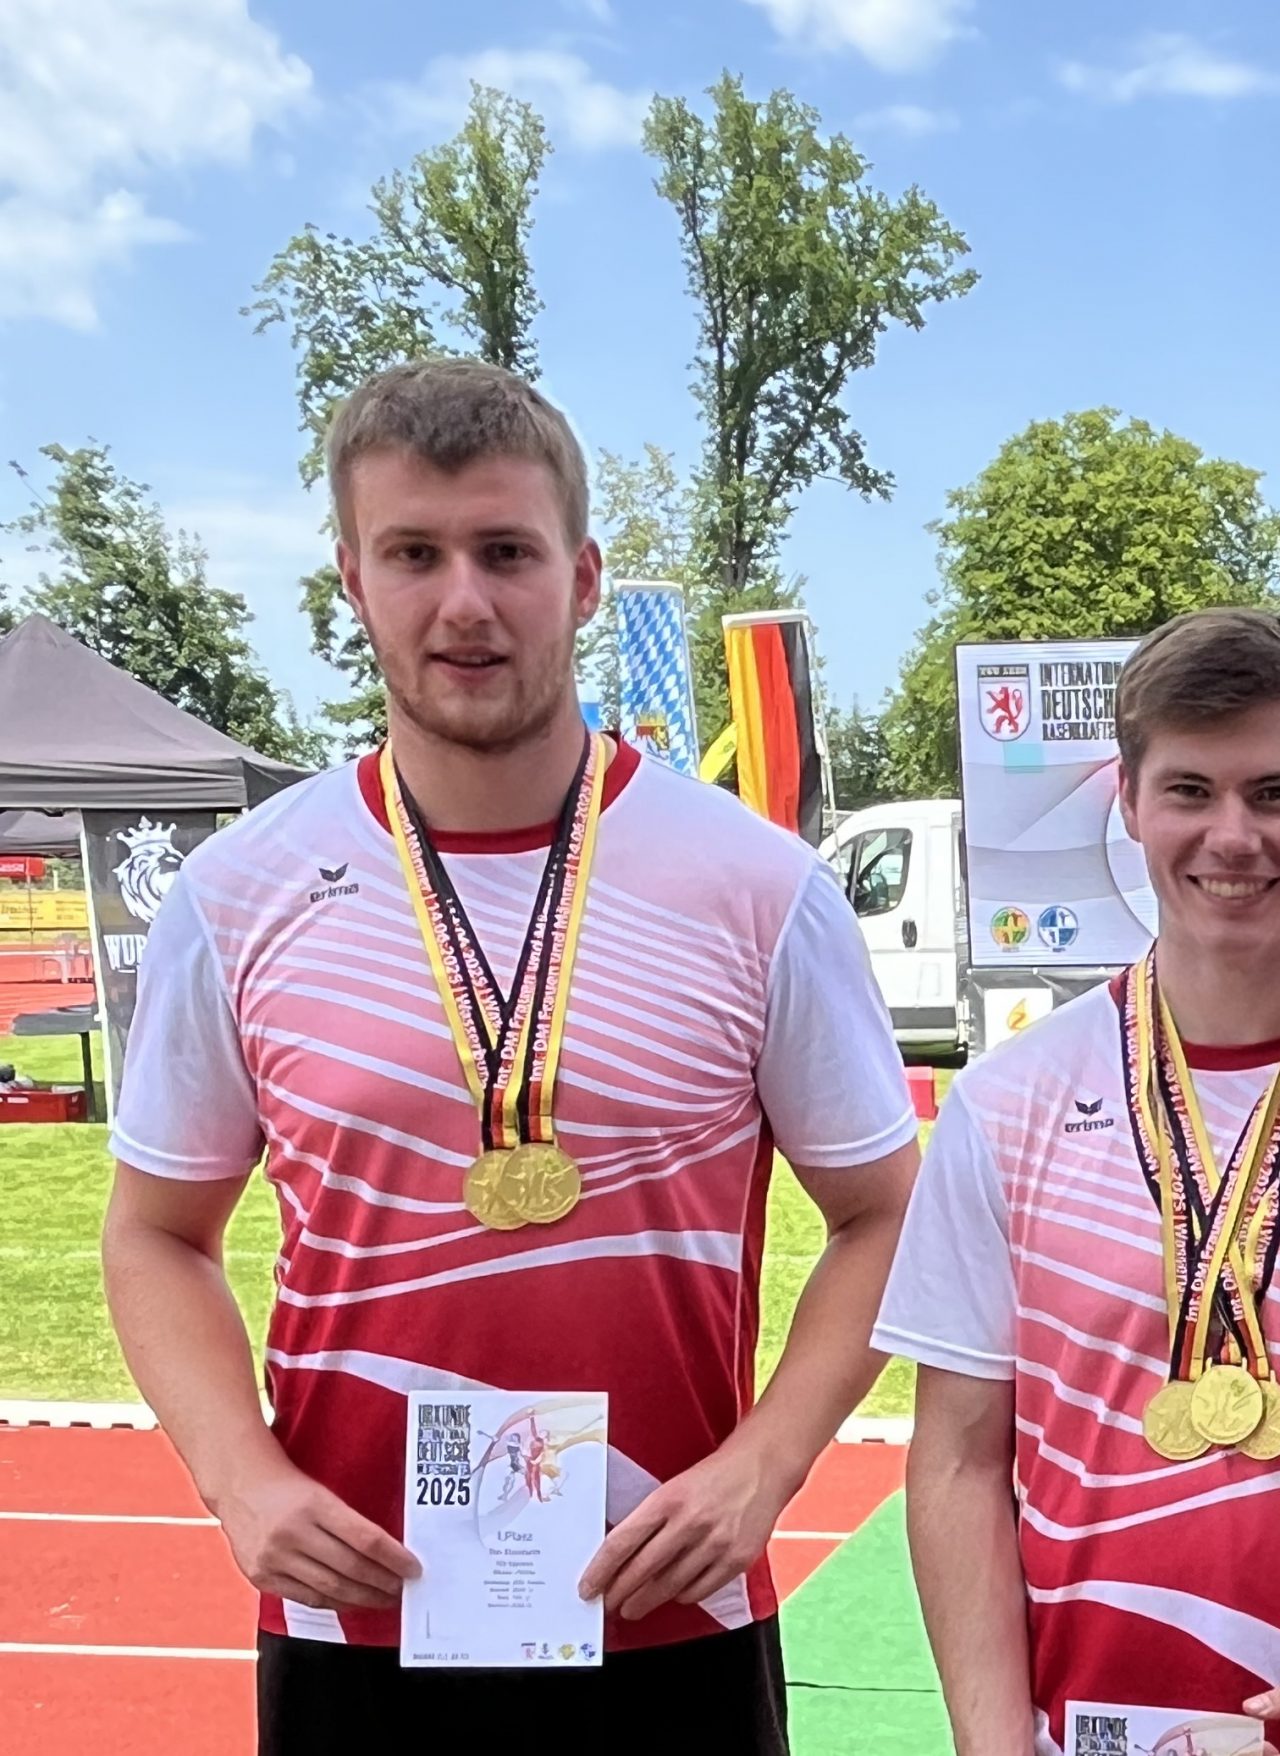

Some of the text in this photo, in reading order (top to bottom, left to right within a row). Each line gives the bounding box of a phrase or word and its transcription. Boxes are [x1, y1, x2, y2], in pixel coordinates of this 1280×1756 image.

[1040, 662, 1123, 686] INTERNATION
[1041, 688, 1115, 720] DEUTSCH
[553, 872, 576, 929] Männer
[549, 932, 565, 963] und
[500, 1030, 517, 1060] DM
[527, 938, 542, 971] und
[538, 965, 558, 1020] Frauen
[534, 1025, 549, 1052] DM
[1178, 1114, 1201, 1170] Männer
[1201, 1204, 1228, 1258] Frauen
[1192, 1261, 1211, 1292] DM
[416, 1477, 471, 1506] 2025
